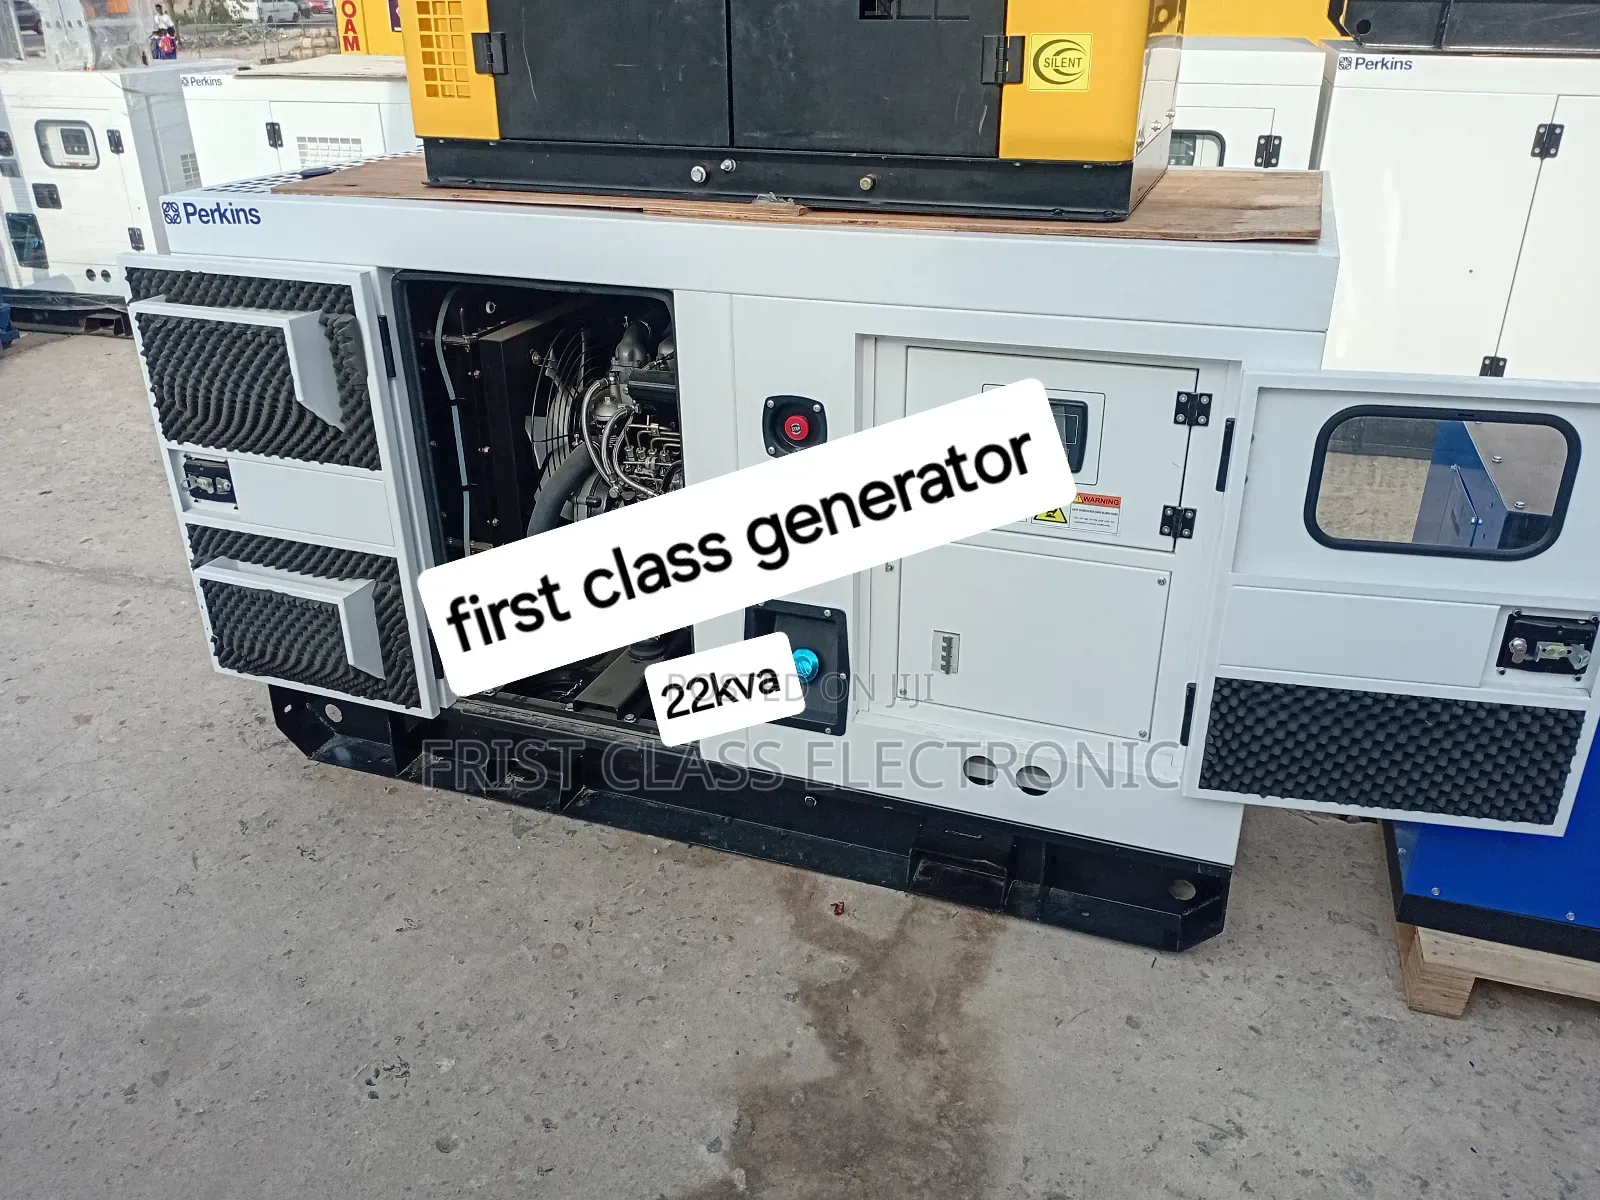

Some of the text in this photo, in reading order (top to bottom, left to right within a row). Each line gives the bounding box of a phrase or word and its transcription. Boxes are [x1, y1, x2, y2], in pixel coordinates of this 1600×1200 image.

[1044, 57, 1083, 68] SILENT
[1354, 56, 1413, 71] Perkins
[190, 76, 223, 87] Perkins
[182, 202, 262, 225] Perkins
[1083, 496, 1120, 506] WARNING
